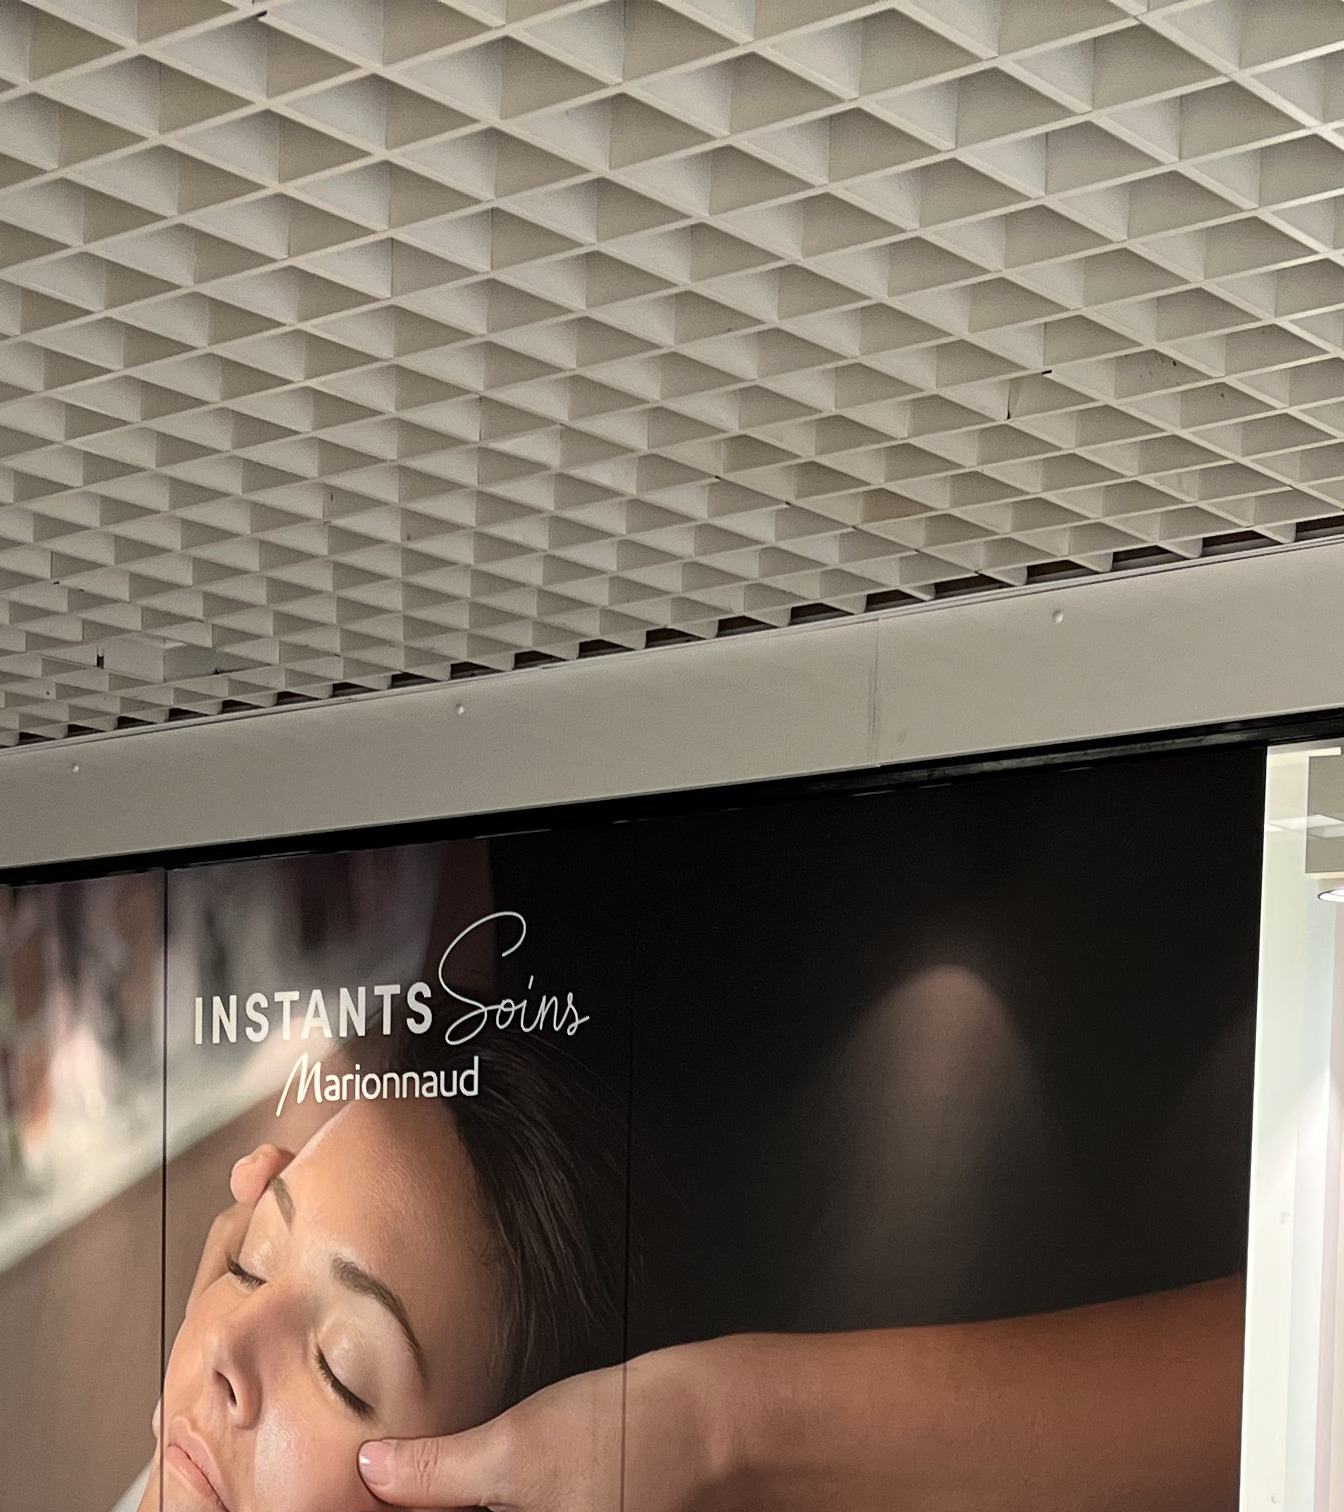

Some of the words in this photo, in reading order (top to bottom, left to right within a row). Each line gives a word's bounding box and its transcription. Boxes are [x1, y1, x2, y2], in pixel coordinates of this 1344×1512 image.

[193, 981, 433, 1045] INSTANTS
[438, 911, 590, 1045] Soins
[275, 1051, 480, 1118] Marionnaud
